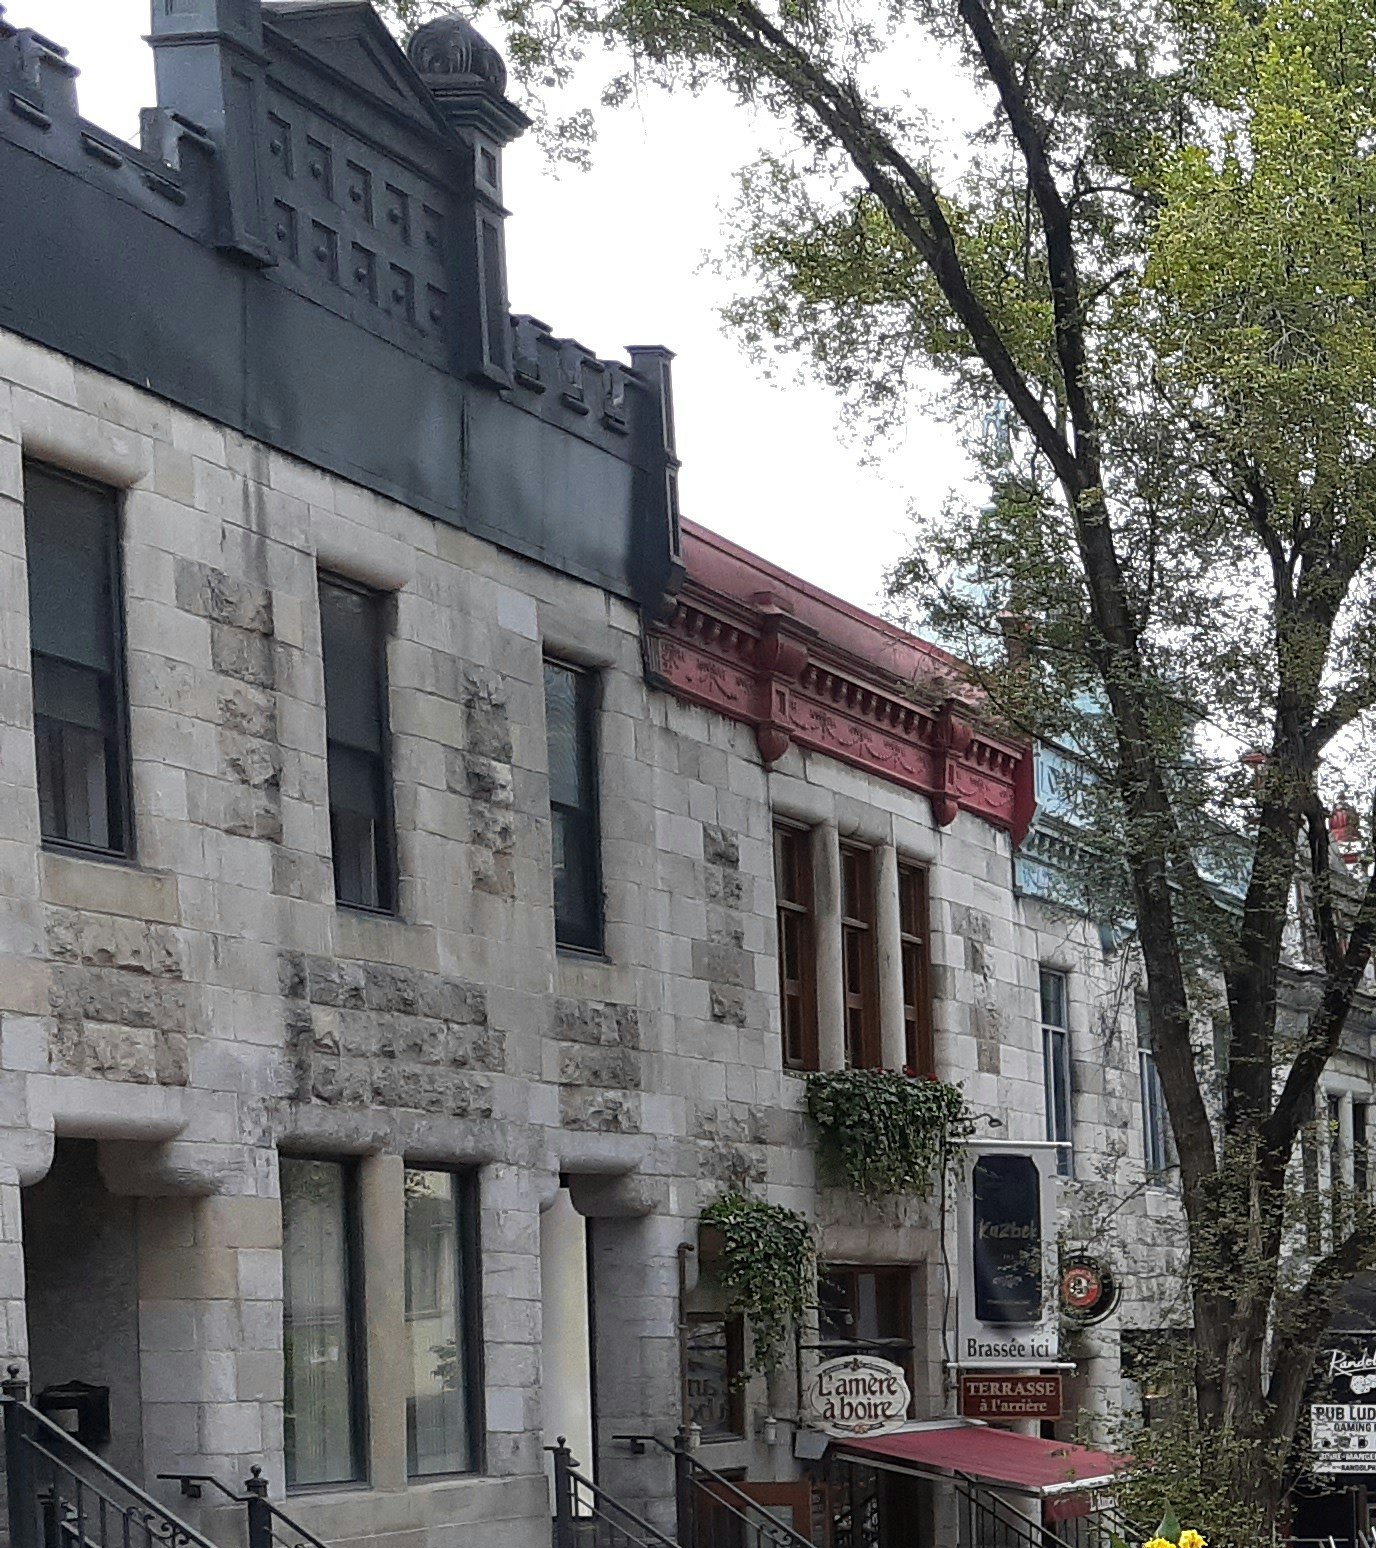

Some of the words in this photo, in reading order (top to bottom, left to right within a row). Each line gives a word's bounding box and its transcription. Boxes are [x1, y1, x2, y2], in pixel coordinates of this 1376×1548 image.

[967, 1337, 1026, 1357] Brassée
[1030, 1338, 1049, 1357] ici
[818, 1373, 898, 1396] L'amère
[966, 1382, 1057, 1397] TERRASSE
[823, 1398, 836, 1420] à
[839, 1396, 893, 1420] boire
[979, 1398, 989, 1412] à
[990, 1399, 1048, 1412] l'arrière
[1315, 1406, 1346, 1421] PUB
[1333, 1422, 1372, 1433] GAMING
